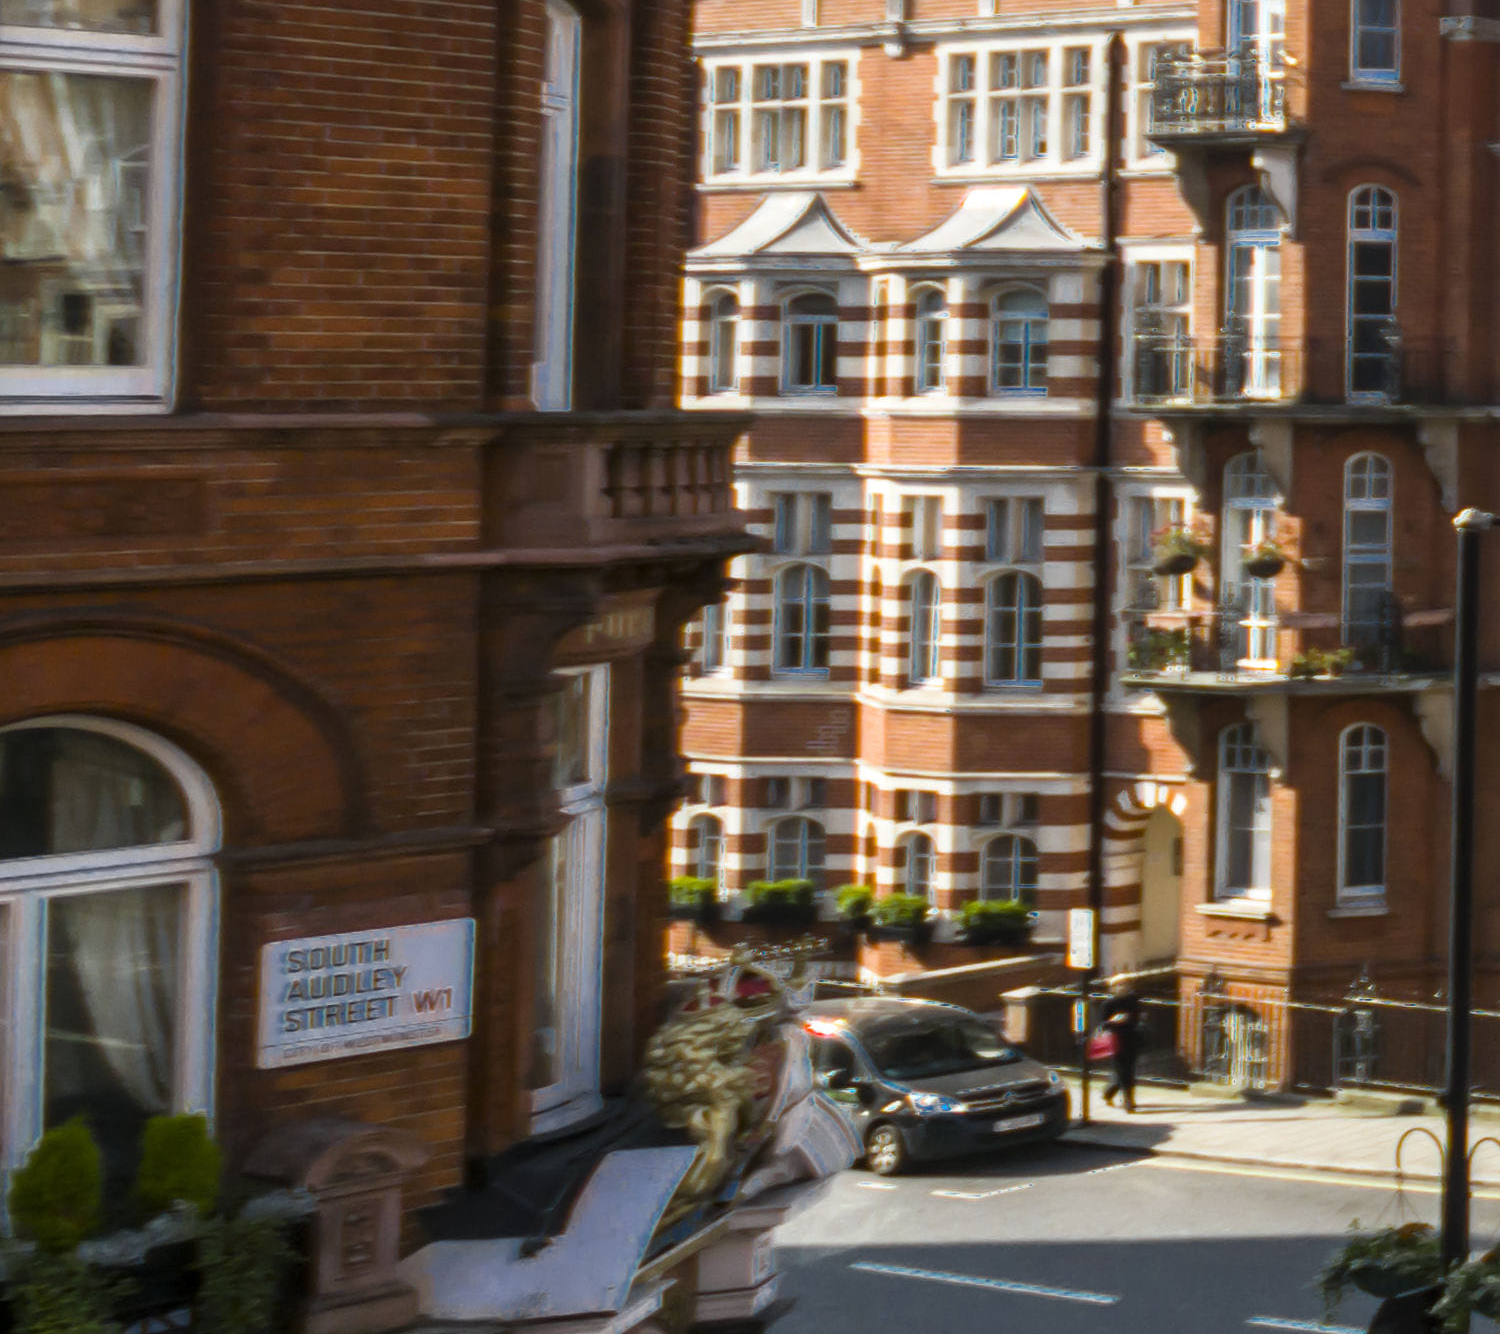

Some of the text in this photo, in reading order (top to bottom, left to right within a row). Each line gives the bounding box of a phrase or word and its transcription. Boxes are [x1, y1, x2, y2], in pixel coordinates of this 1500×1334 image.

[286, 939, 390, 974] SOUTH
[285, 967, 408, 1002] AUDLEY
[283, 987, 453, 1033] STREET W1
